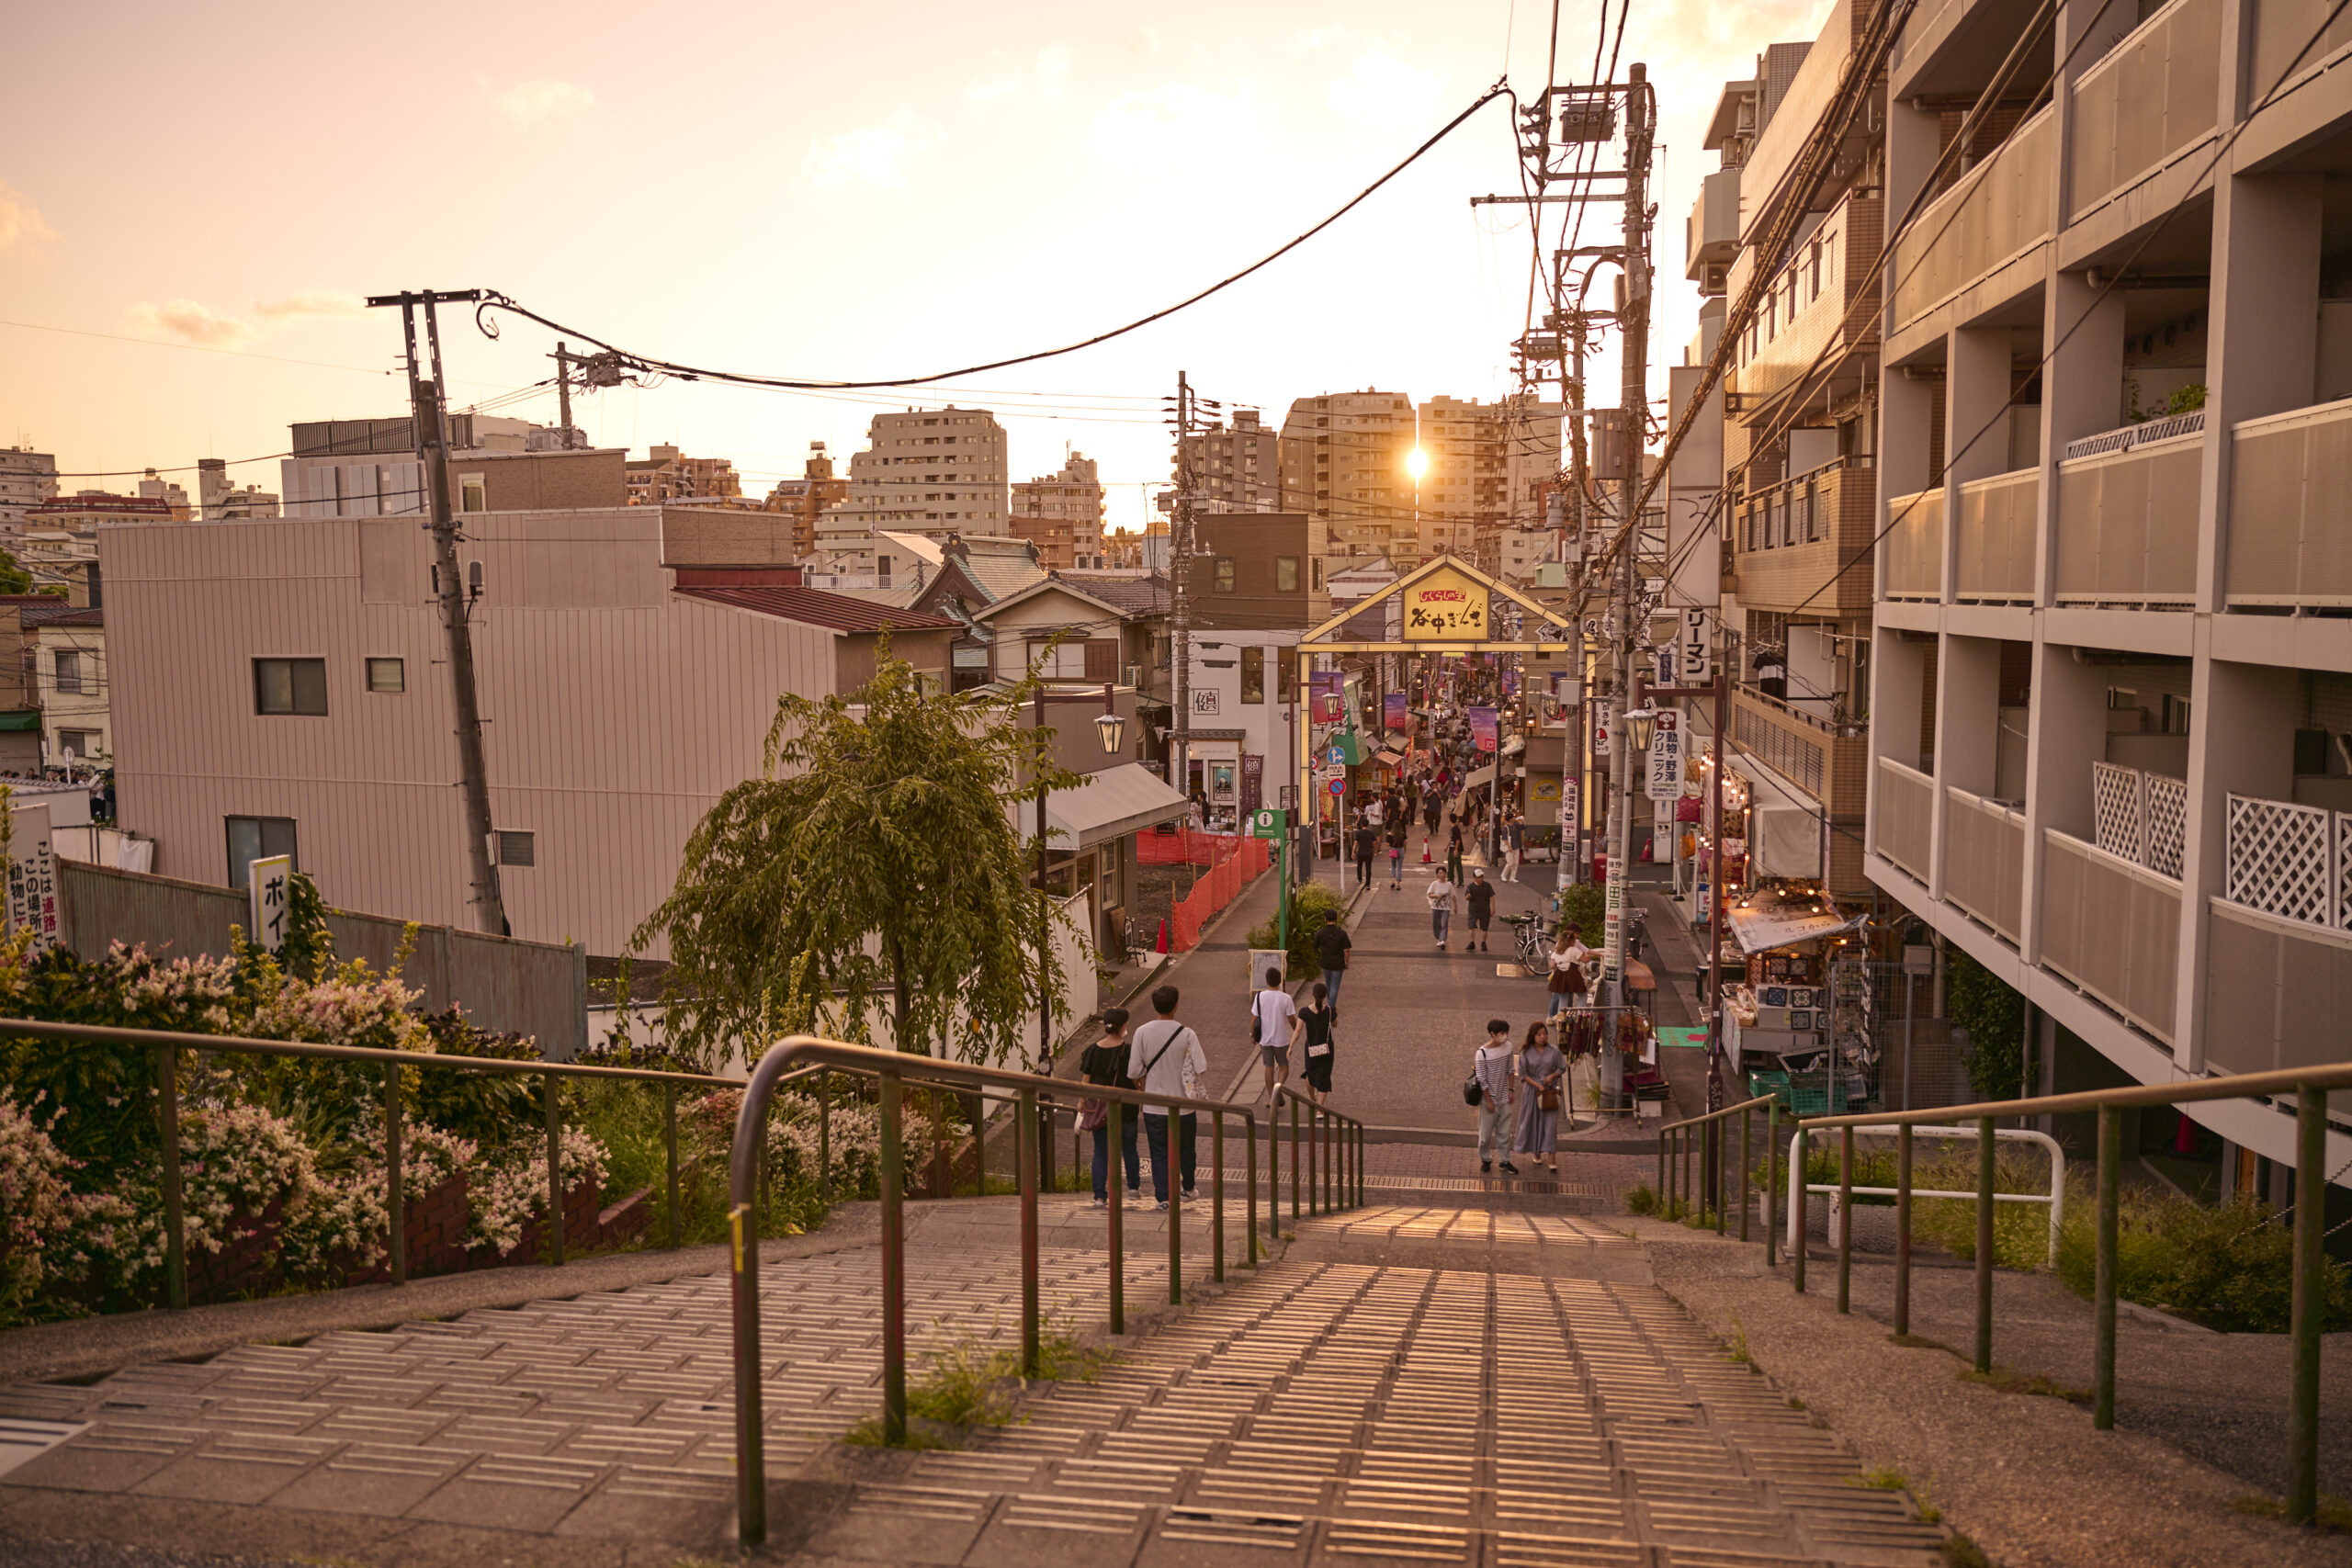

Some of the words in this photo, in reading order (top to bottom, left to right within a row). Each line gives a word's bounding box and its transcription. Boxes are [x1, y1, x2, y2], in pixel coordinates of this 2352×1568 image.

[1409, 599, 1483, 634] 谷中ぎんざ
[1686, 608, 1705, 673] リーマン
[1653, 731, 1665, 782] クリニック
[1665, 731, 1679, 782] 動物・野澤
[8, 862, 29, 969] 動物にエを
[25, 858, 44, 958] この場所で
[265, 874, 289, 989] ポイ捨
